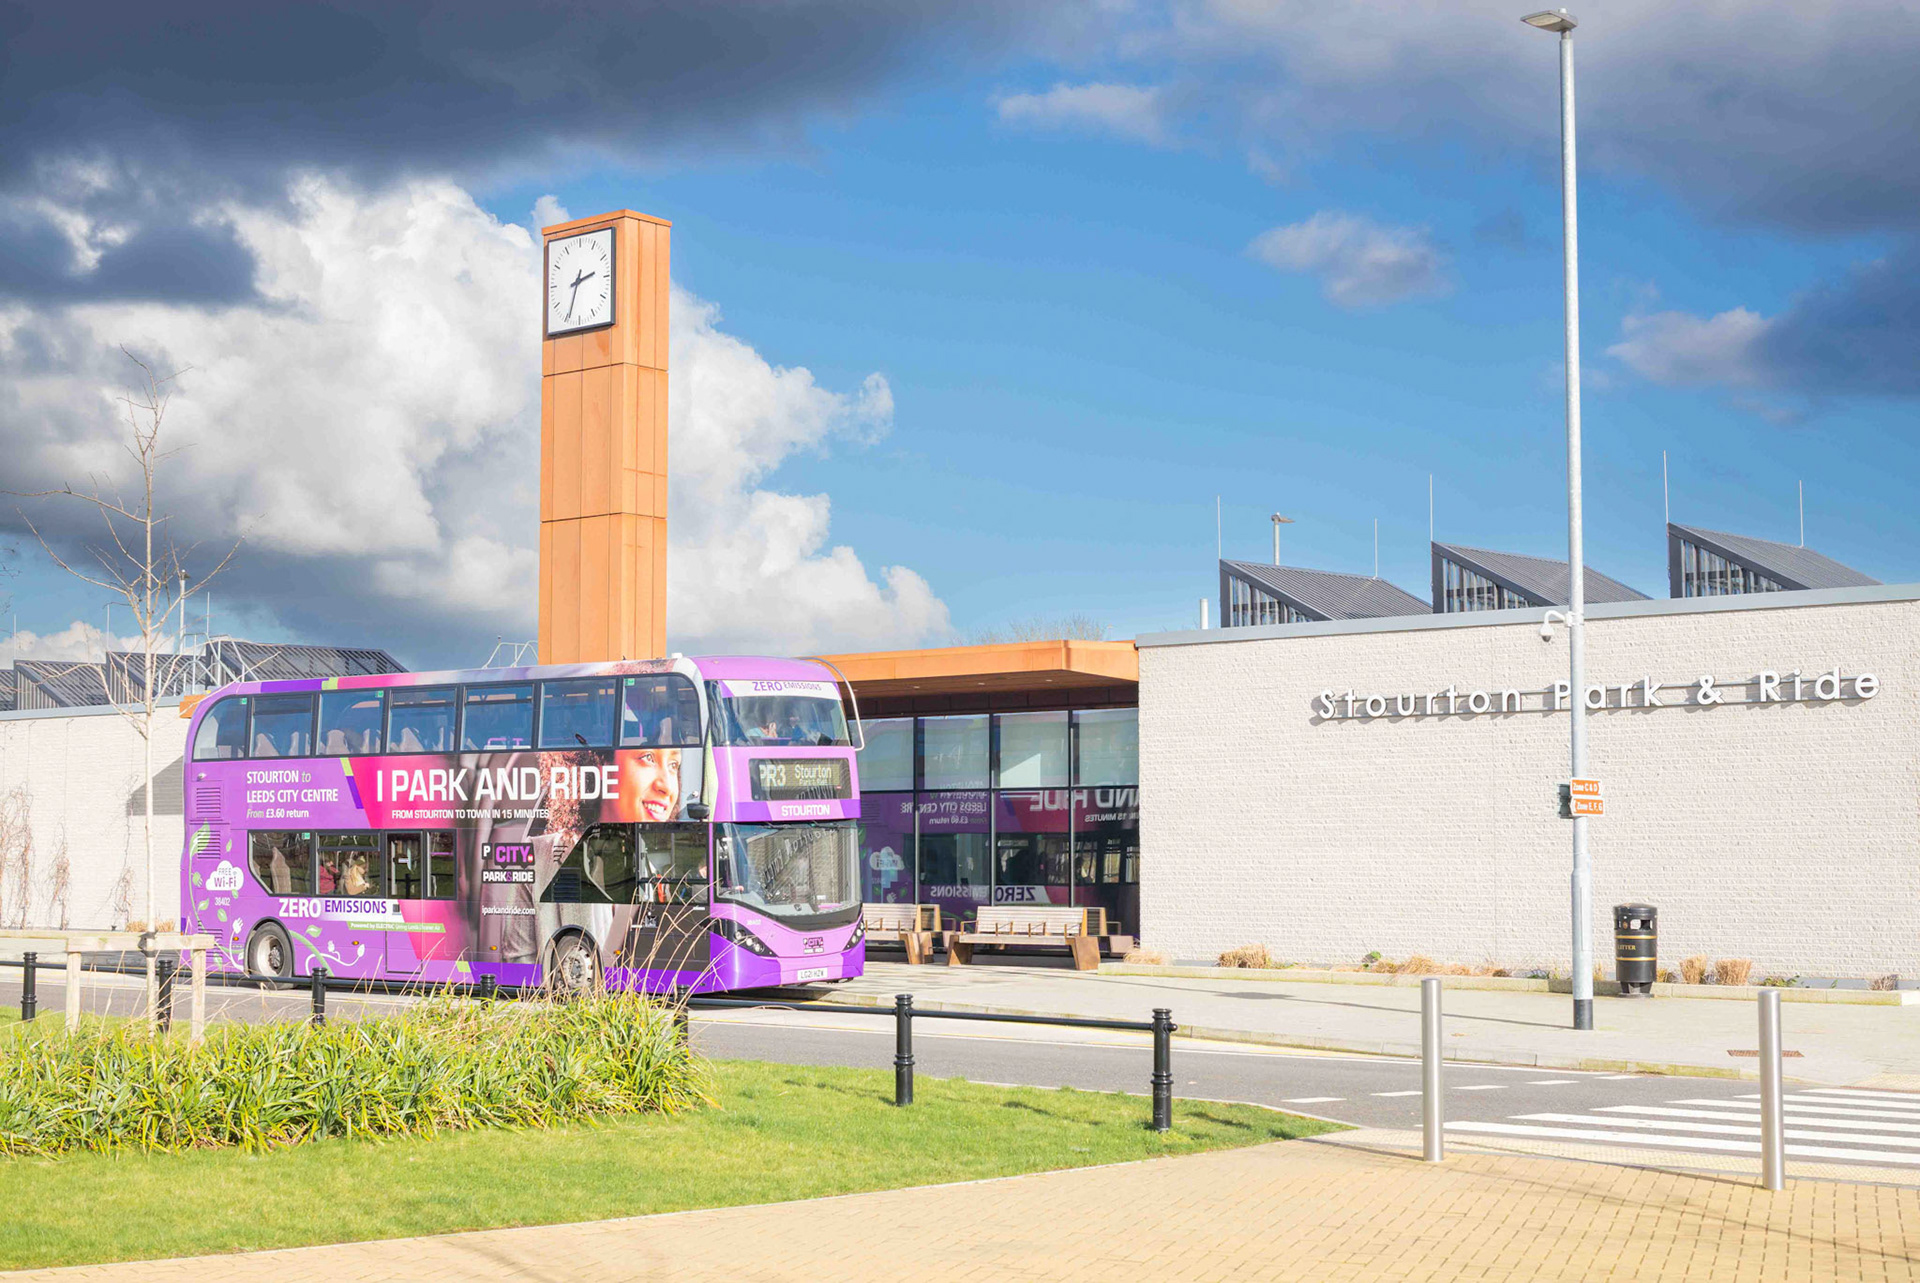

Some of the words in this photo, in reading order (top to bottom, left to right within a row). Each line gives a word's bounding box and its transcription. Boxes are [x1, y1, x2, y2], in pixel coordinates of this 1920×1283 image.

[752, 681, 783, 691] ZERO
[783, 682, 822, 691] EMISSIONS
[1318, 684, 1522, 720] Stourton
[1554, 675, 1664, 710] Park
[1697, 674, 1725, 705] &
[1760, 667, 1881, 703] Ride
[246, 770, 299, 784] STOURTON
[301, 771, 312, 783] to
[759, 764, 786, 787] PR3
[794, 763, 832, 779] Stourton
[377, 769, 383, 802] I
[392, 768, 469, 802] PARK
[475, 766, 541, 801] AND
[550, 765, 619, 800] RIDE
[246, 789, 275, 803] LEEDS
[277, 789, 299, 803] CITY
[301, 788, 339, 802] CENTRE
[246, 808, 265, 818] From
[265, 808, 285, 818] £3.60
[286, 809, 310, 818] return
[392, 810, 414, 819] FROM
[414, 809, 454, 819] STOURTON
[455, 809, 465, 819] TO
[466, 809, 491, 819] TOWN
[492, 809, 501, 819] IN
[501, 809, 513, 819] 15
[513, 809, 550, 819] MINUTES
[781, 804, 831, 816] STOURTON
[483, 845, 491, 857] P
[495, 845, 531, 863] CITY
[218, 867, 232, 876] FREE
[214, 876, 237, 888] Wi-Fi
[278, 898, 322, 918] ZERO
[324, 899, 387, 914] EMISSIONS
[481, 905, 536, 916] iparkandride.com
